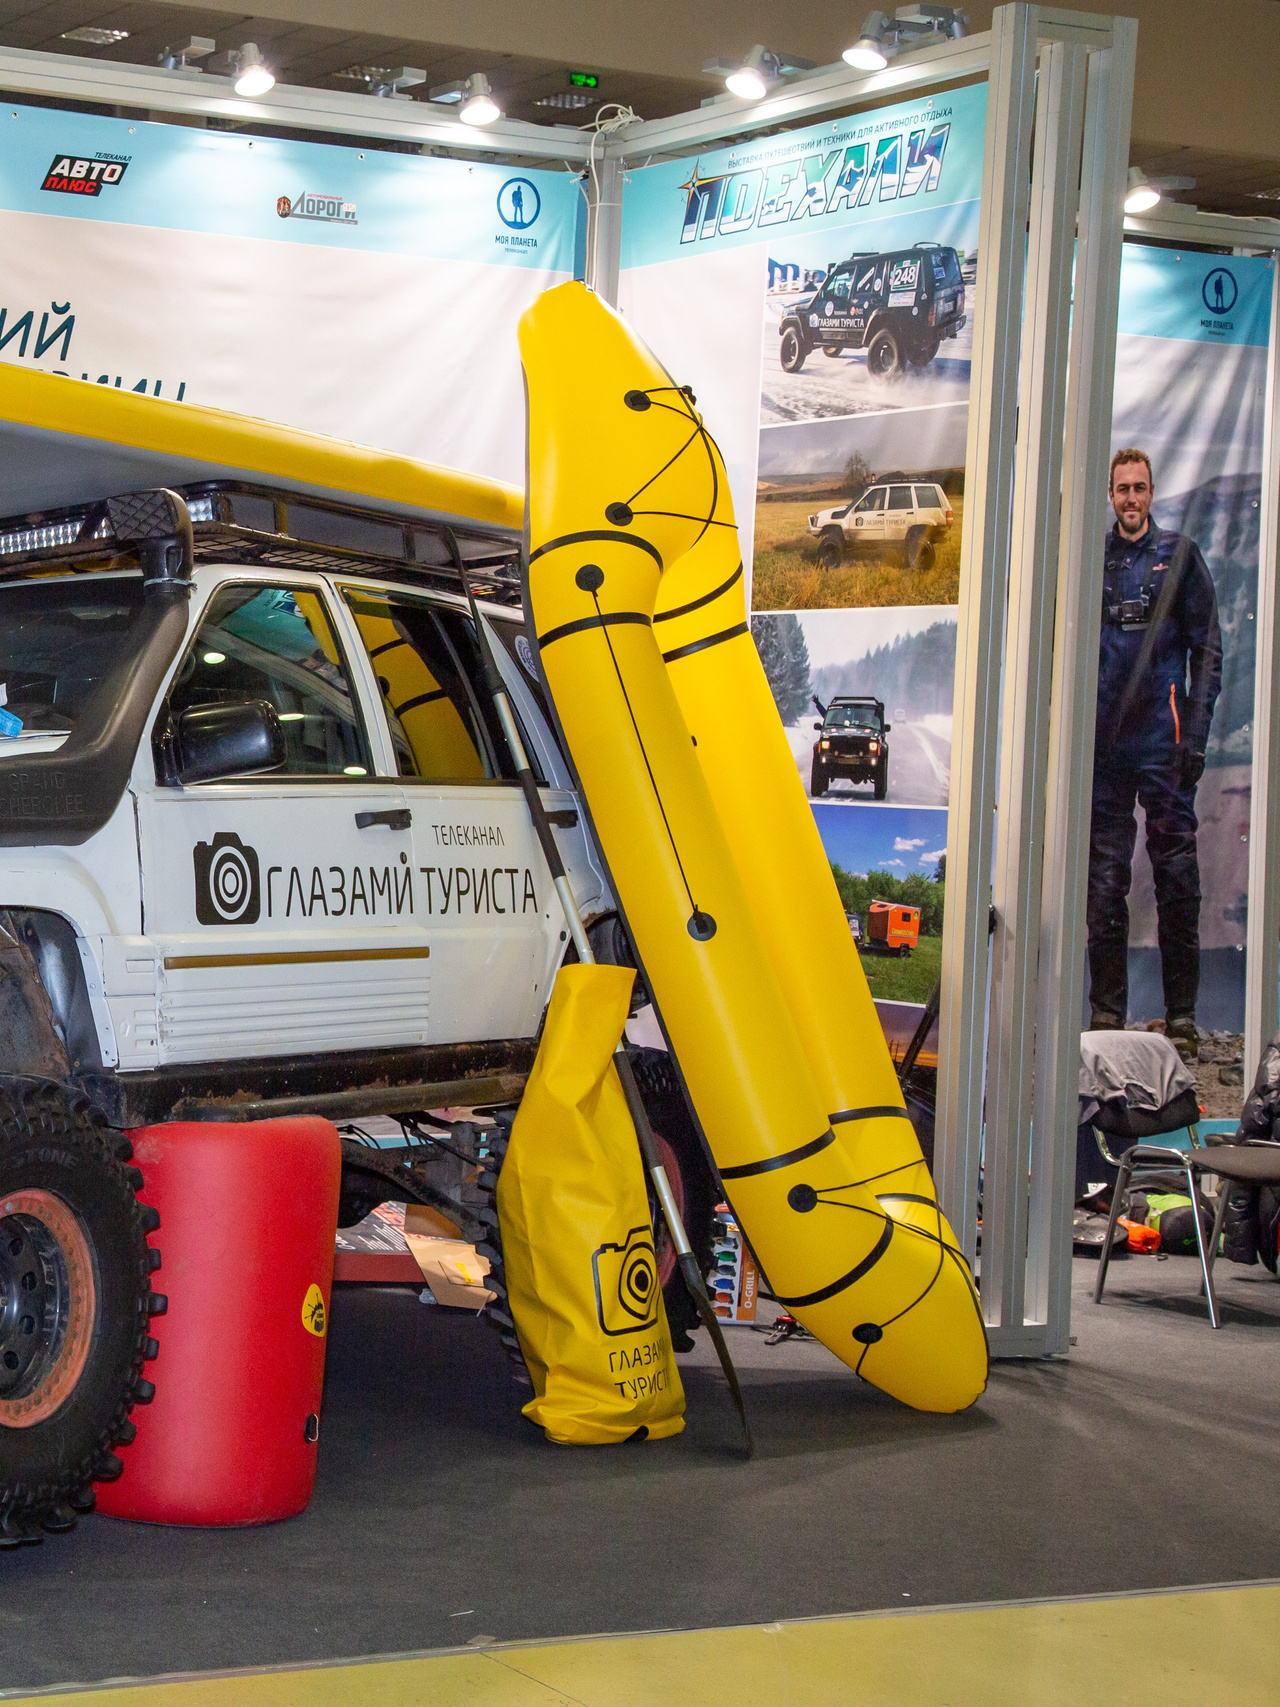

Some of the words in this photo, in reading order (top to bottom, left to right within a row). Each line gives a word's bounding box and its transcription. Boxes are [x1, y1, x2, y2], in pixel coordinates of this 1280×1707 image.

[728, 153, 763, 169] ВЫСТАВКА
[765, 140, 815, 158] ПУТЕШЕСТВИЙ
[823, 129, 856, 146] ТЕХНИКИ
[857, 126, 873, 140] ДЛЯ
[874, 114, 919, 134] АКТИВНОГО
[920, 107, 953, 123] ОТДЫХА
[95, 151, 132, 162] ТЕЛЕКАНАЛ
[51, 158, 123, 183] АВТО
[45, 176, 97, 193] ПЛЮС
[680, 123, 951, 244] ПОЕХАЛИ
[495, 234, 509, 245] МОЯ
[510, 236, 538, 248] ПЛАНЕТА
[893, 266, 916, 286] 248
[841, 318, 865, 328] ТУРИСТА
[432, 824, 505, 847] ТЕЛЕКАНАЛ
[267, 866, 413, 917] ГЛАЗАМИ
[420, 867, 538, 915] ТУРИСТА
[744, 1269, 756, 1309] O-GRILL
